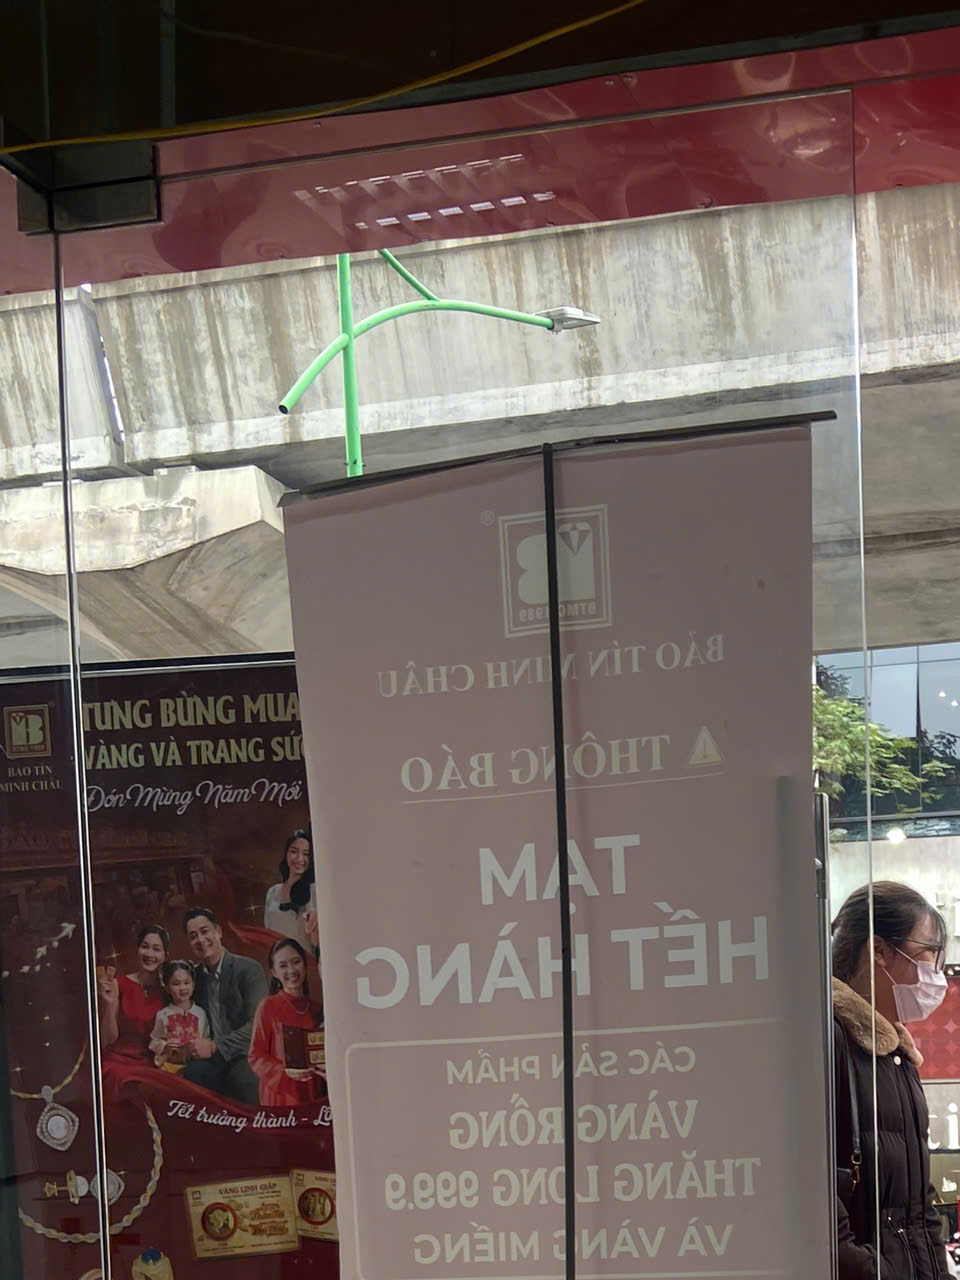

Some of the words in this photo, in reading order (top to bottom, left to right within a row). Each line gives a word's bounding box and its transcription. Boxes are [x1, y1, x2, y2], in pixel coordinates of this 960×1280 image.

[243, 692, 301, 724] MUA
[149, 736, 183, 767] VÀ
[187, 738, 265, 765] TRANG
[271, 730, 304, 762] SỨ
[126, 783, 194, 815] Mừng
[195, 780, 251, 809] Năm
[251, 778, 302, 807] Mới
[167, 1100, 195, 1119] Tết
[196, 1105, 248, 1133] trưởng
[252, 1109, 297, 1128] thành
